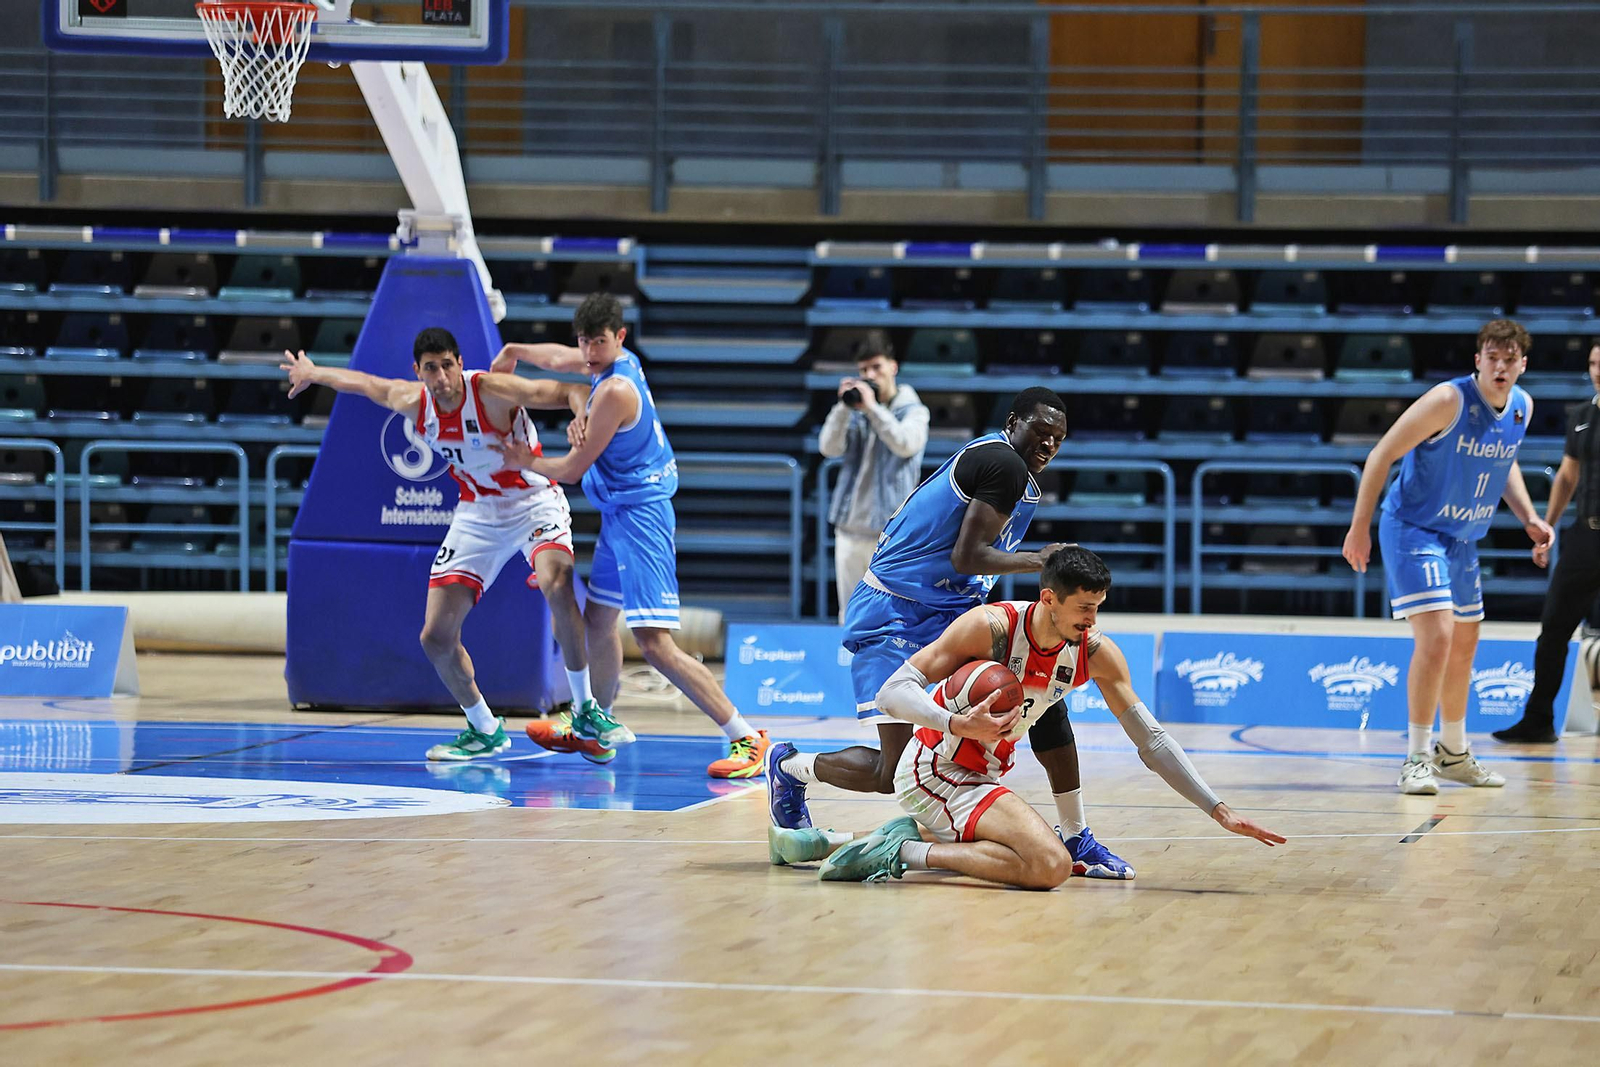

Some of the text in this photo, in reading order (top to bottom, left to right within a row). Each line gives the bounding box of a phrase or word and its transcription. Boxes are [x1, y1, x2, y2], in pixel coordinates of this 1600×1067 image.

[424, 11, 463, 22] PLATA
[1456, 434, 1517, 459] Huelva
[1474, 473, 1490, 498] 11
[381, 505, 457, 525] Internationa
[1422, 560, 1441, 587] 11
[0, 639, 95, 665] publibit
